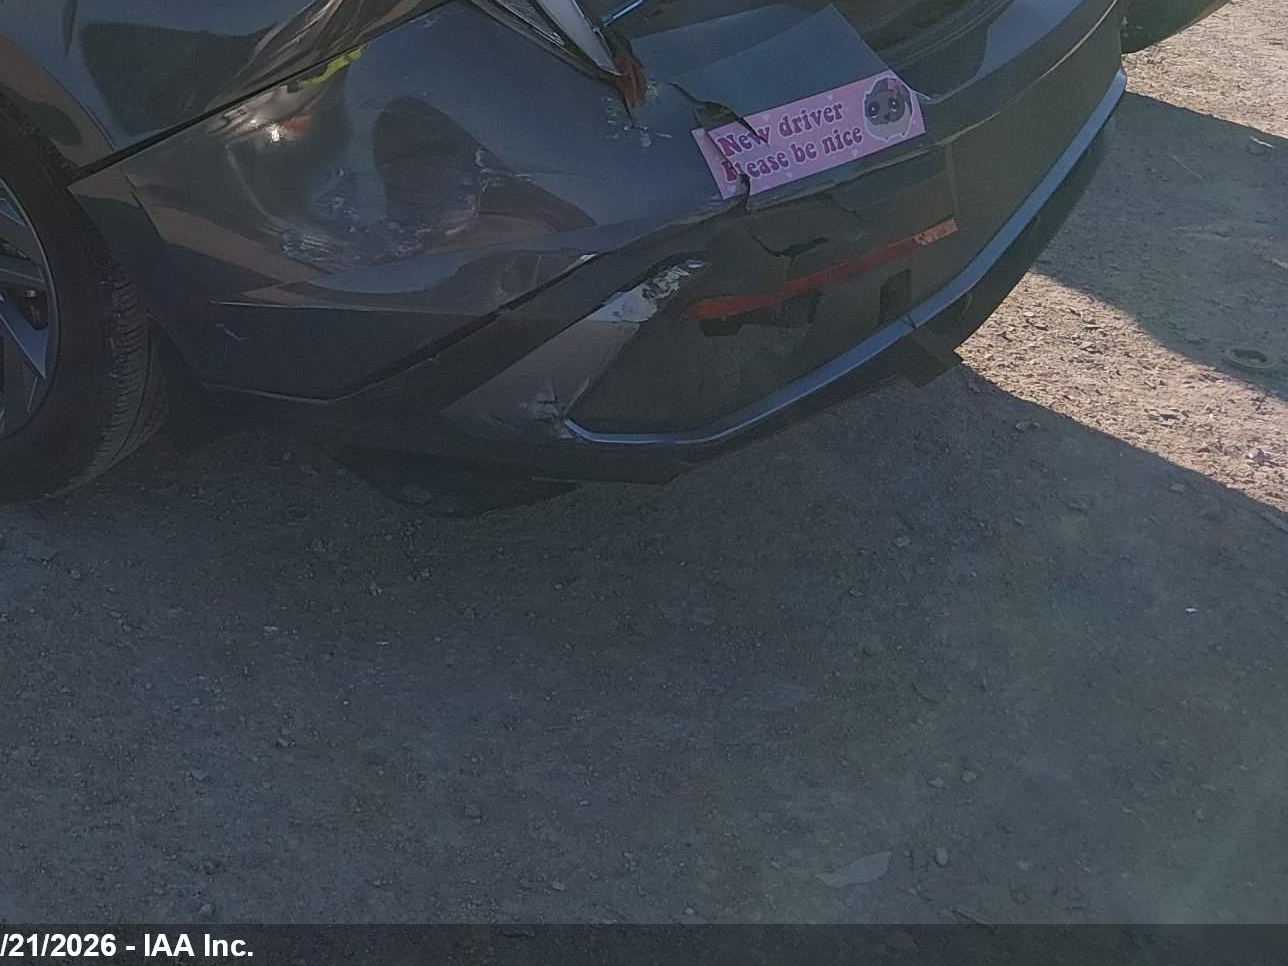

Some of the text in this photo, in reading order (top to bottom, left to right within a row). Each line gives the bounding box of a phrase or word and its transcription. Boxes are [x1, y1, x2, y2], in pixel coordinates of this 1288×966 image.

[717, 102, 843, 157] New driver
[793, 142, 817, 163] be
[823, 126, 863, 155] nice
